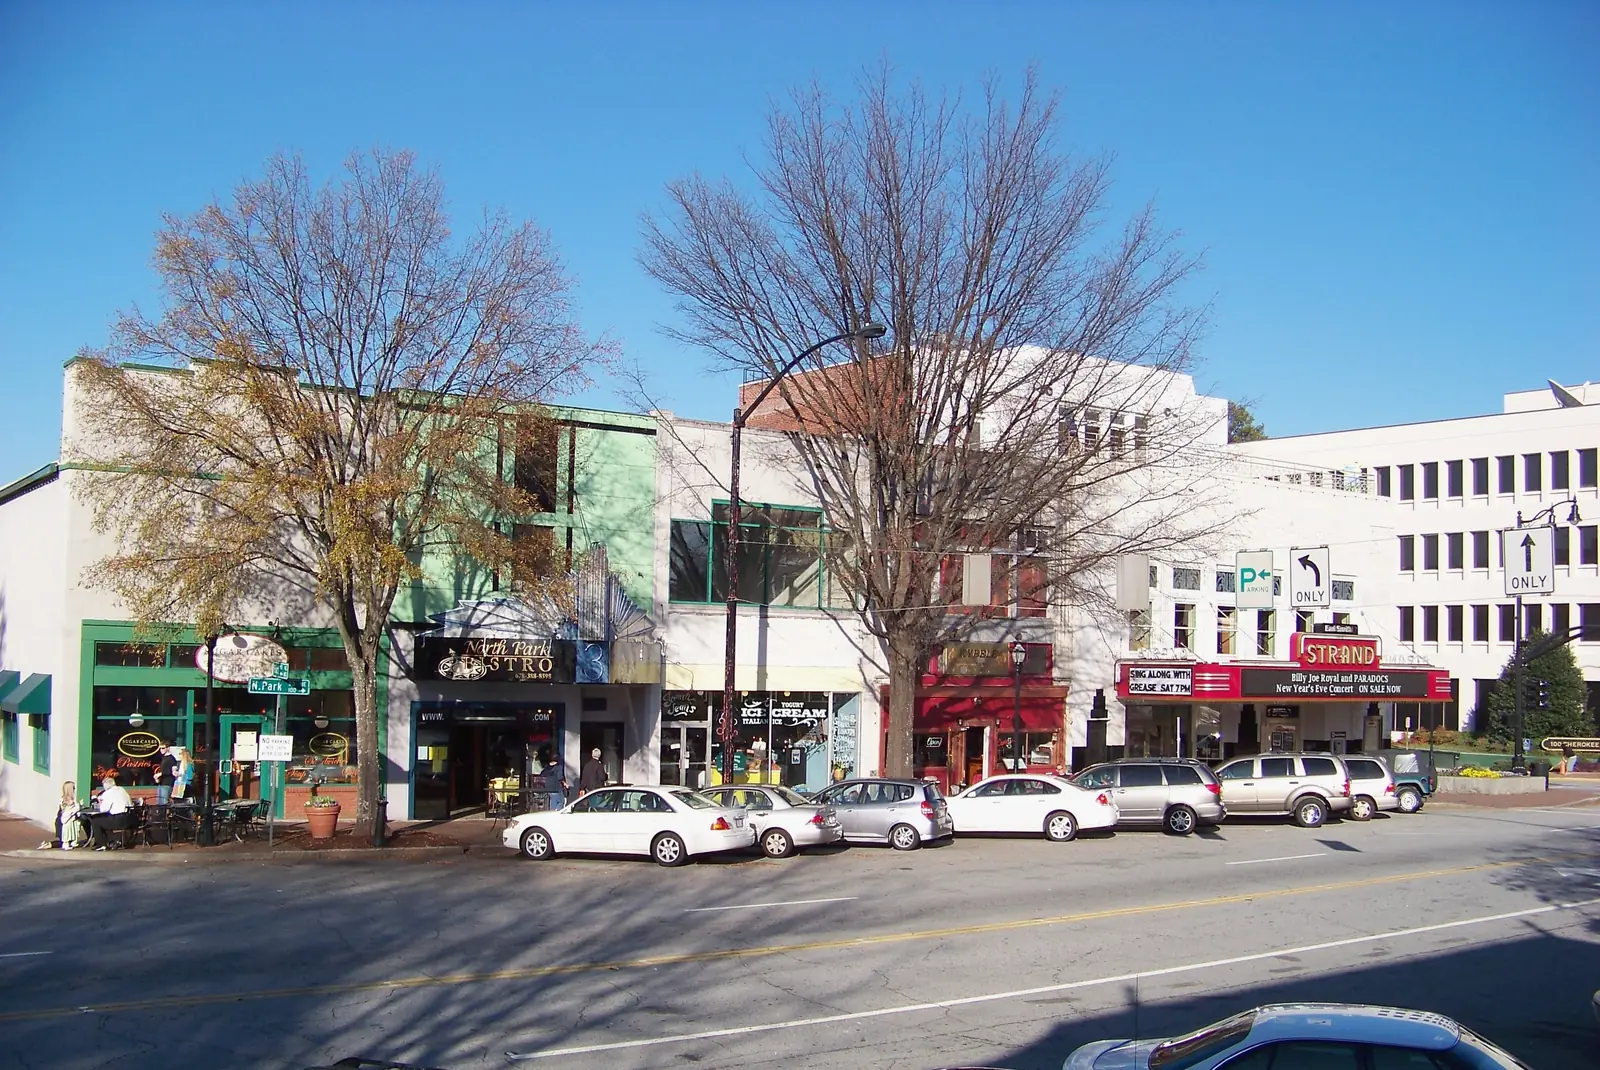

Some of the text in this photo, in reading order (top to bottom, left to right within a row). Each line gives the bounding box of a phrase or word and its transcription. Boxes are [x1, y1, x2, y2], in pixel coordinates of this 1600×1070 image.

[1511, 575, 1547, 589] ONLY
[1296, 590, 1325, 603] ONLY
[464, 640, 552, 656] North Park
[1306, 643, 1375, 665] STRAND
[461, 656, 553, 673] BISTRO
[583, 643, 603, 681] 3
[1130, 670, 1191, 680] SING ALONG WITH
[1291, 673, 1389, 684] Billy Joe Royal and PARADOCS
[1129, 683, 1157, 692] GREASE
[1160, 684, 1174, 692] SAT
[1276, 684, 1402, 694] New Year's Eve Concert ON SALE NOW
[532, 713, 550, 721] .COM
[741, 708, 827, 718] ICE CREAM
[926, 737, 940, 746] Open
[116, 757, 152, 769] Pastries
